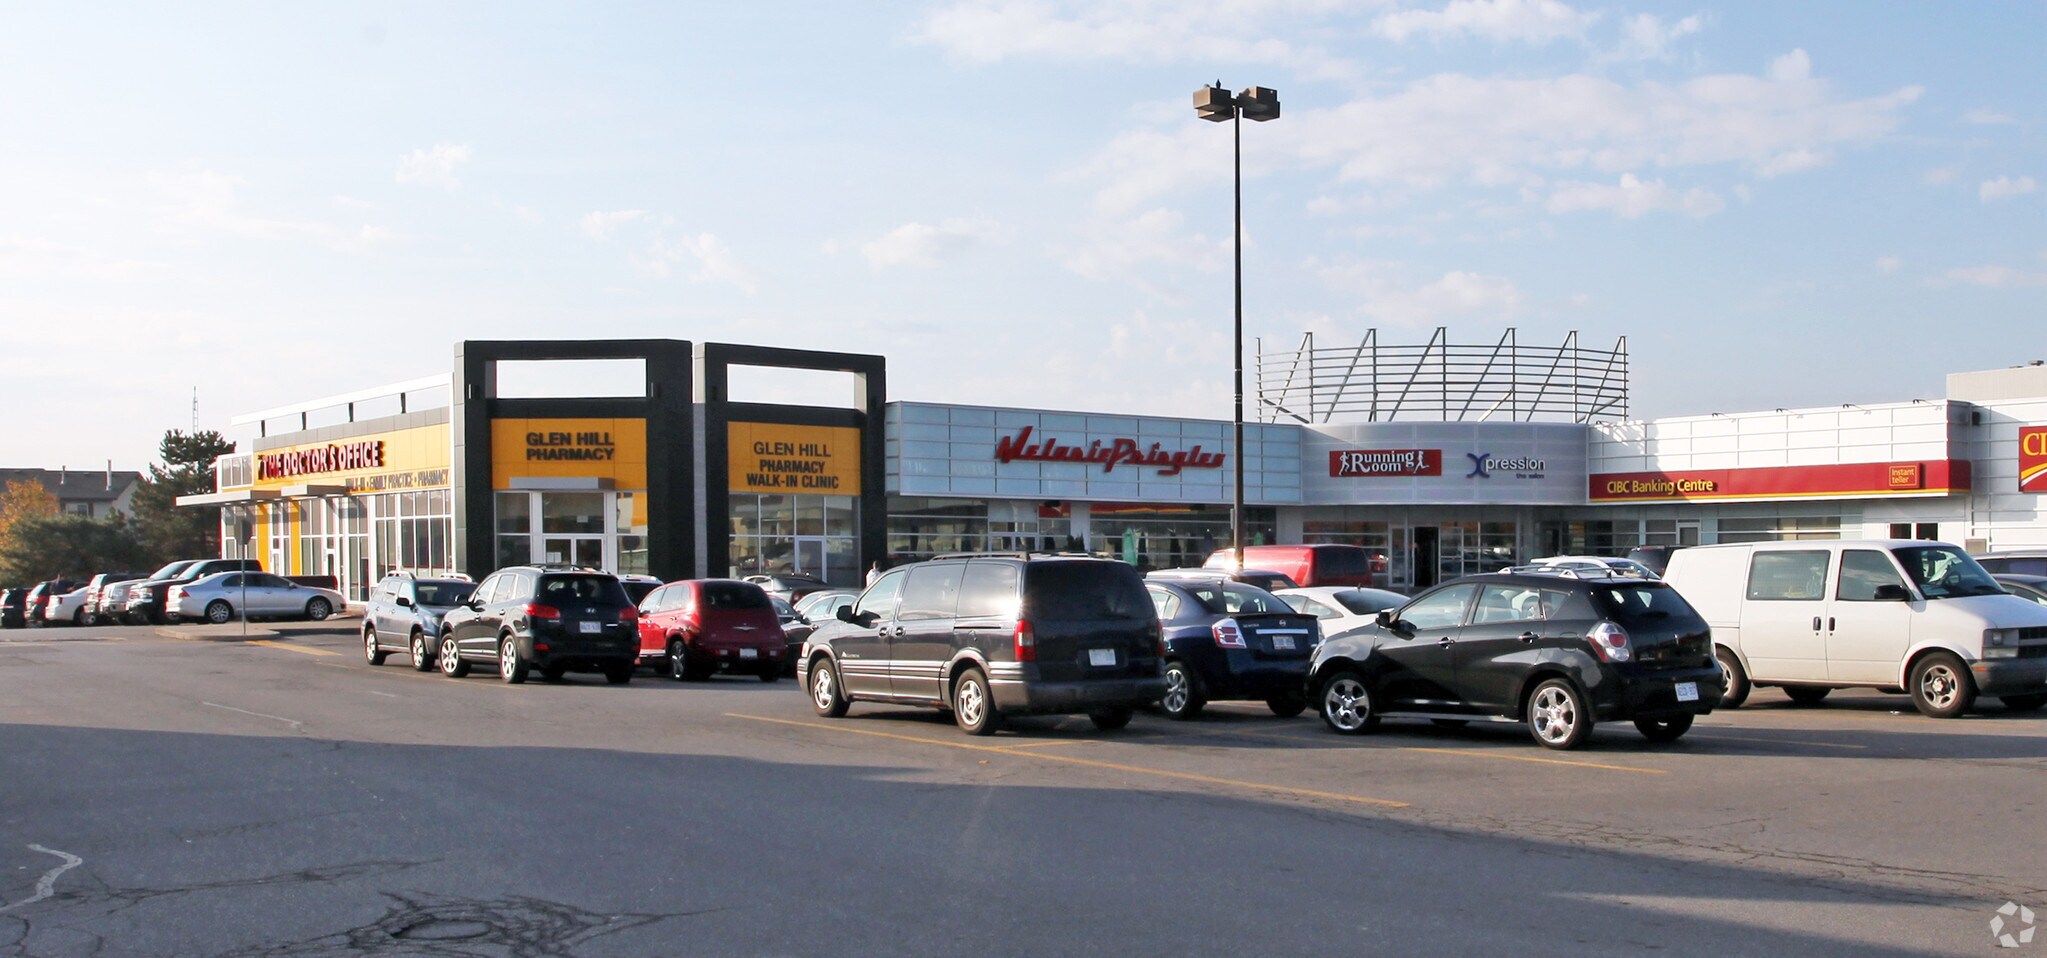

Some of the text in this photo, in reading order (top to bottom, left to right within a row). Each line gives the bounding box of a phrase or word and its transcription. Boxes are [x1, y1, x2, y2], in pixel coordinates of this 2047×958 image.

[526, 432, 615, 446] GLEN HILL
[526, 448, 615, 461] PHARMACY
[753, 441, 832, 457] GLEN HILL
[261, 440, 380, 478] THE DOCTOR'S OFFICE
[760, 459, 826, 474] PHARMACY
[1351, 450, 1415, 472] Running
[746, 473, 839, 489] WALK-IN CLINIC
[1607, 479, 1714, 495] CIBC Banking Centre
